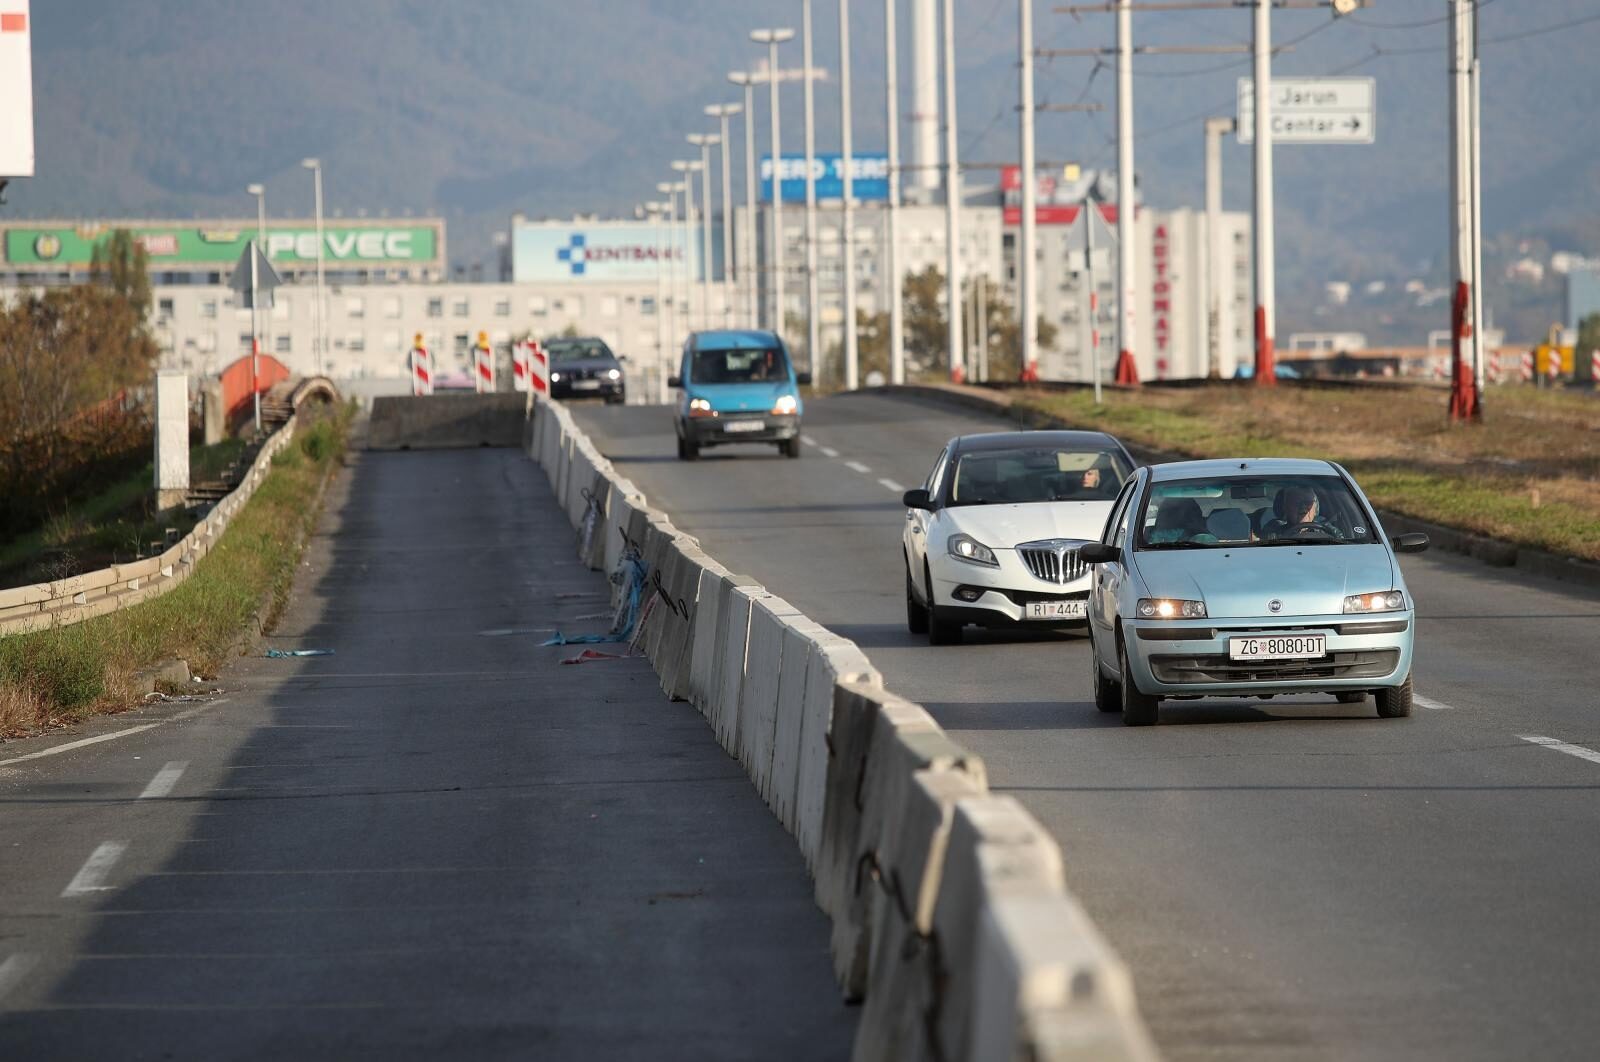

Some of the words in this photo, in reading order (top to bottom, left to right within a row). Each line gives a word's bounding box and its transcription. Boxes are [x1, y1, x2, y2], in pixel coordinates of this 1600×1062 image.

[1278, 87, 1337, 106] Jarun
[1271, 116, 1334, 133] Centar
[267, 231, 412, 258] PEVEC
[1034, 604, 1047, 616] RI
[1240, 639, 1258, 655] ZG
